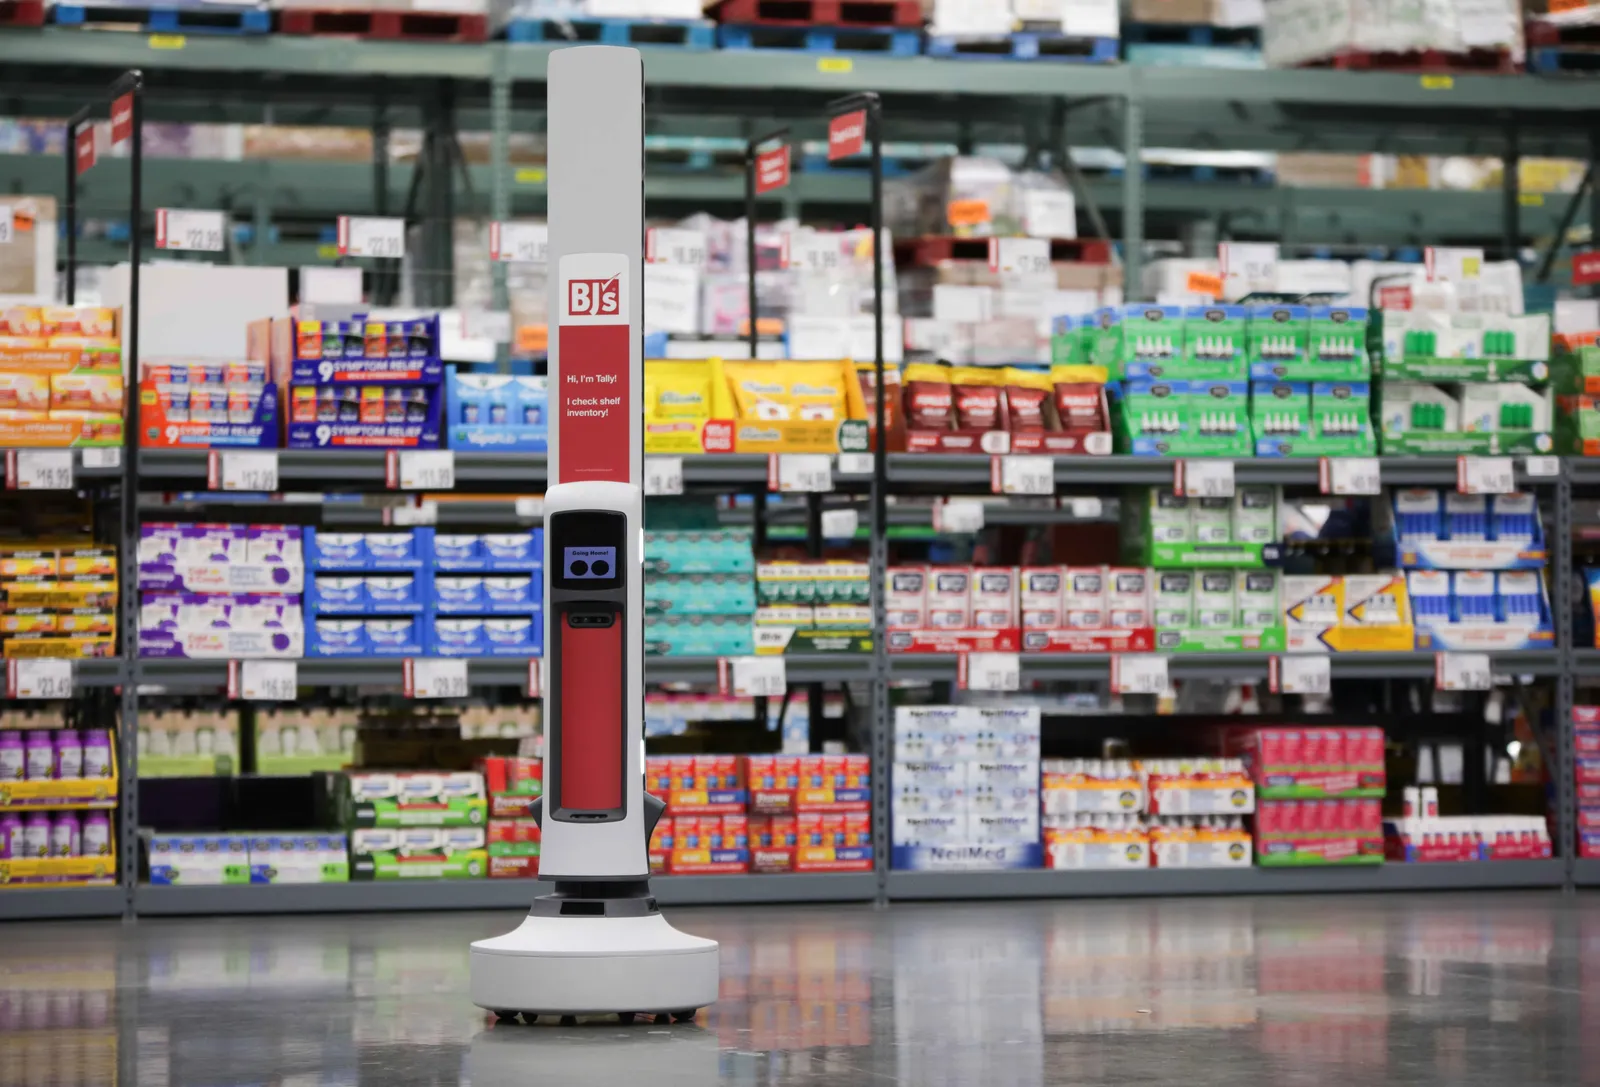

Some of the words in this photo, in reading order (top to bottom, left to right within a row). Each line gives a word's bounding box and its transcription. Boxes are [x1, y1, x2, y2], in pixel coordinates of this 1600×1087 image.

[318, 361, 334, 382] 9
[334, 360, 387, 372] SYMPTOM
[389, 359, 426, 371] RELIEF
[566, 374, 579, 384] Hi,
[580, 374, 594, 383] I'm
[595, 374, 617, 385] Tally!
[571, 396, 598, 406] check
[599, 396, 621, 406] shelf
[566, 408, 609, 418] inventory!
[165, 426, 179, 444] 9
[179, 426, 229, 437] SYMPTOM
[231, 425, 263, 437] RELIEF
[316, 425, 331, 446] 9
[331, 425, 385, 437] SYMPTOM
[386, 424, 423, 436] RELIEF
[930, 846, 1006, 861] NeilMed
